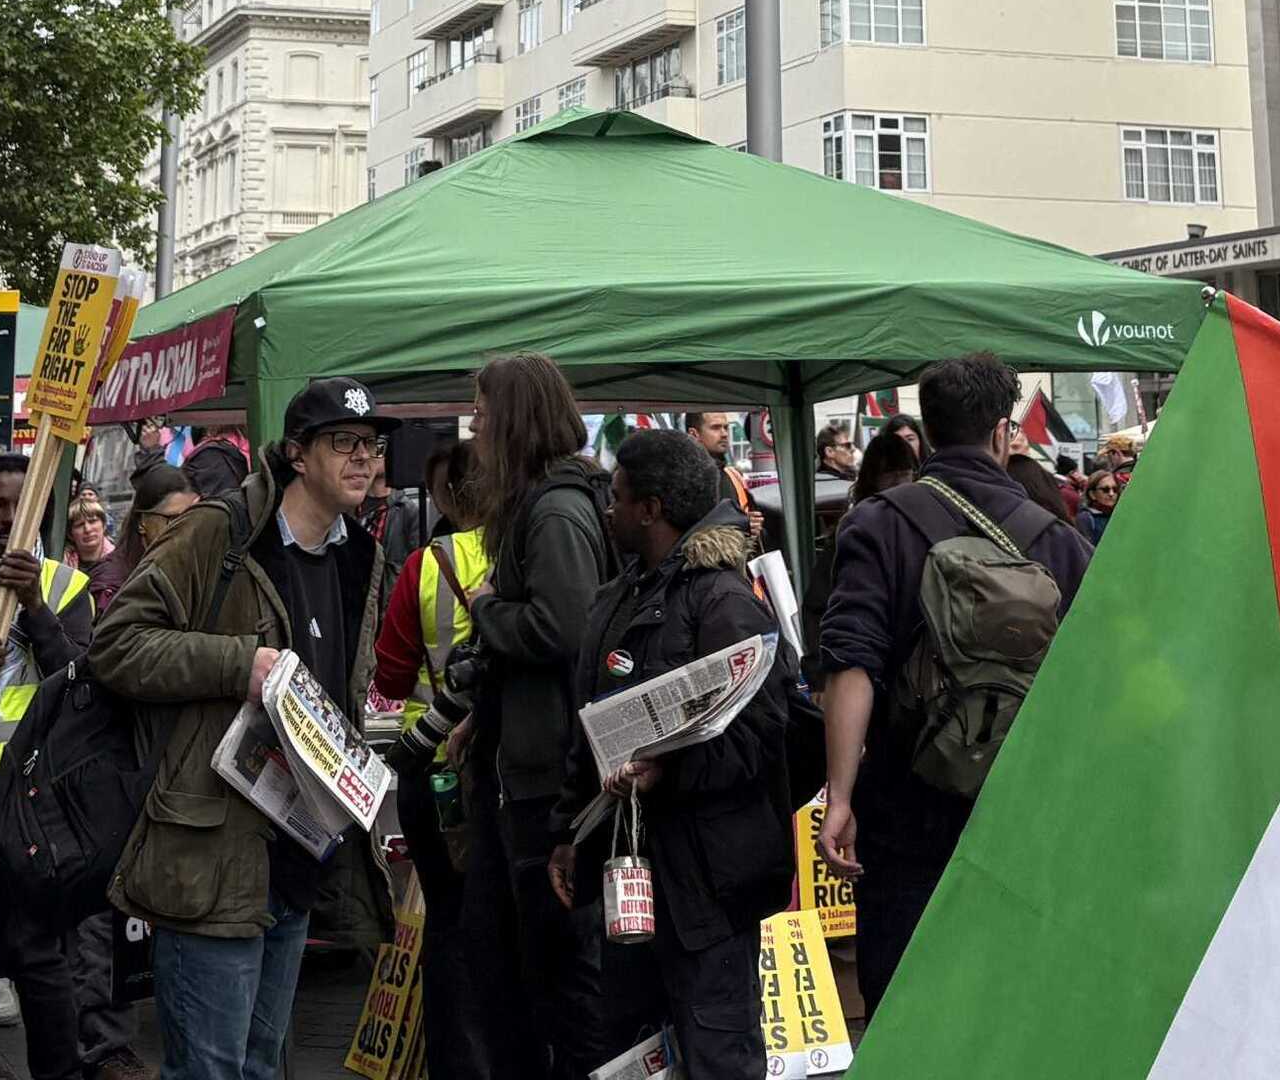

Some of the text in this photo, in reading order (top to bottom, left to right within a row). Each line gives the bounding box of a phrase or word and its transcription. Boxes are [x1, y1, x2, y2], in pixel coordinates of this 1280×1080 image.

[1156, 255, 1169, 270] OF
[1172, 246, 1228, 268] LATTER-DAY
[1232, 240, 1268, 259] SAINTS
[62, 274, 99, 302] STOP
[58, 300, 81, 327] THE
[47, 327, 72, 356] FAR
[1113, 324, 1174, 339] vounot
[40, 354, 85, 387] RIGHT
[301, 733, 338, 779] Palestinian
[313, 727, 343, 767] stranded
